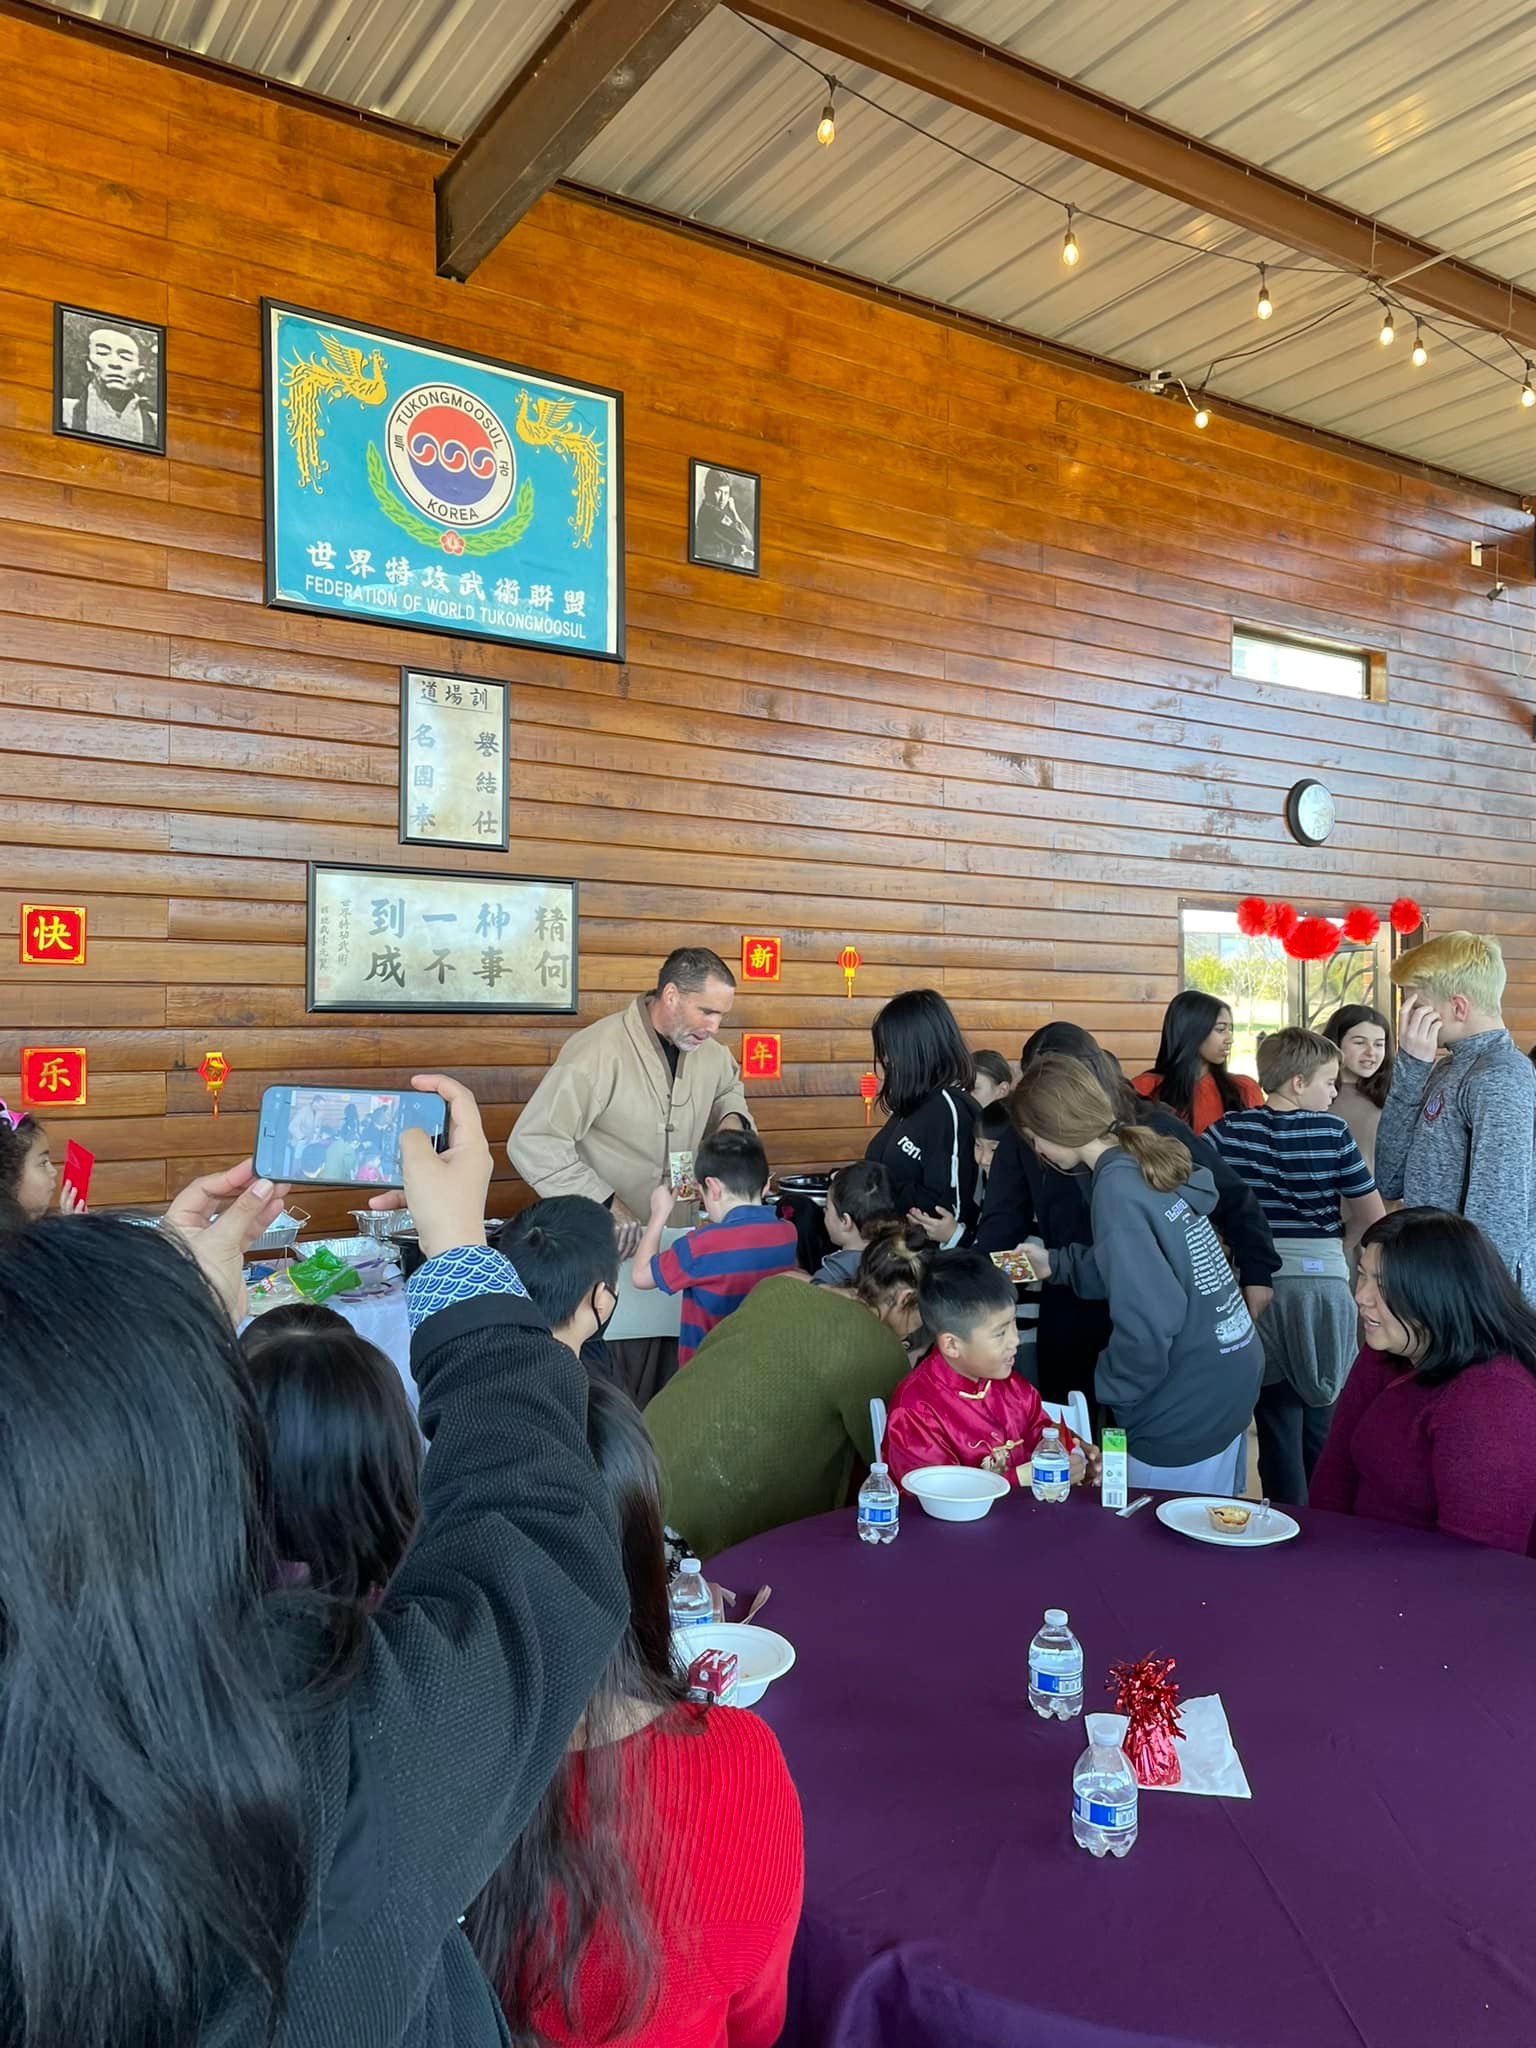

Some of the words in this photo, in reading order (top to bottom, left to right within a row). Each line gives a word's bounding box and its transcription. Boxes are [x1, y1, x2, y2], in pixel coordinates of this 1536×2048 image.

[396, 391, 503, 449] TUKONGMOOSUL
[427, 499, 479, 520] KOREA
[305, 574, 398, 607] FEDERATION
[403, 594, 422, 612] OF
[427, 598, 475, 621] WORLD
[480, 607, 586, 639] TUKONGMOOSUL
[33, 915, 73, 951] 快
[750, 944, 775, 973] 新
[751, 1040, 773, 1070] 年
[38, 1057, 71, 1092] 乐
